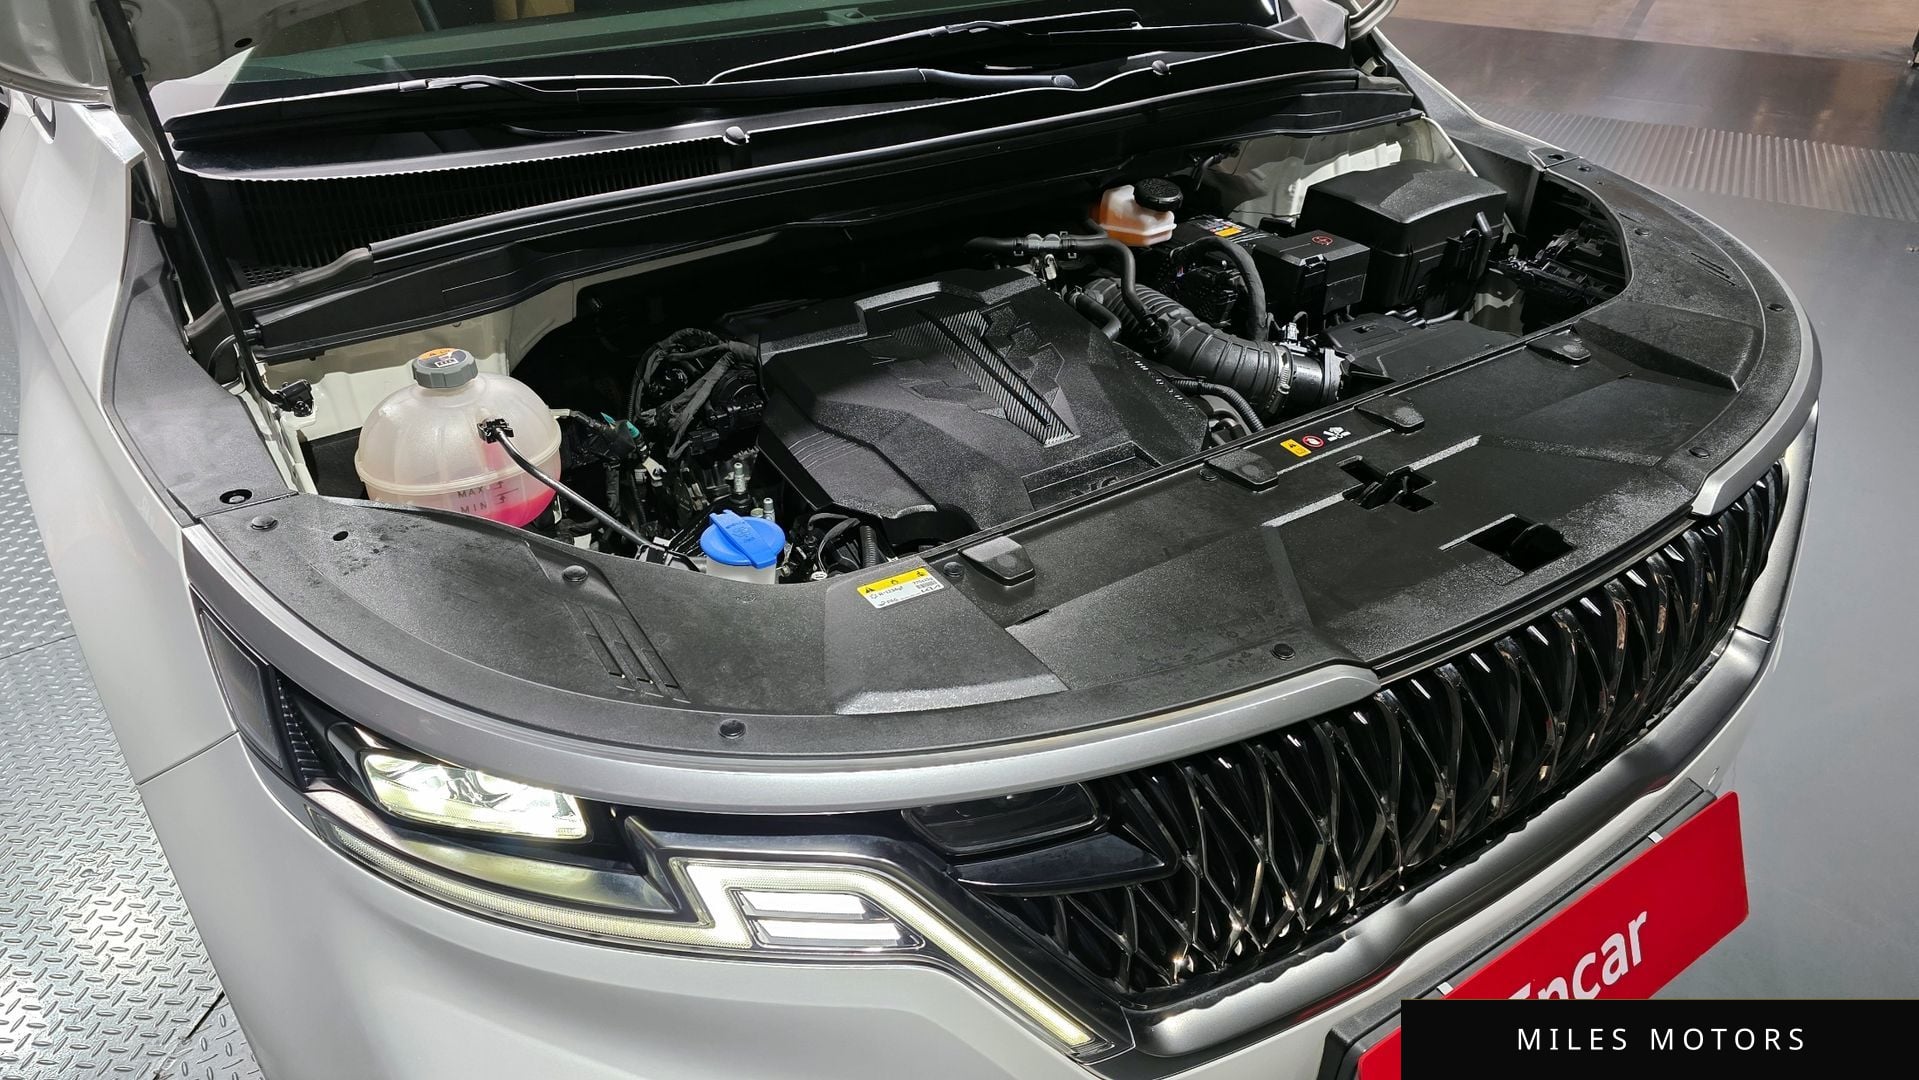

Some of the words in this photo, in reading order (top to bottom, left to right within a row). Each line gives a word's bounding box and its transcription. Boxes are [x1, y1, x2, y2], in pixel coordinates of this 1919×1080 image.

[456, 486, 484, 498] MAX
[461, 502, 487, 513] MIN
[1508, 911, 1647, 999] car
